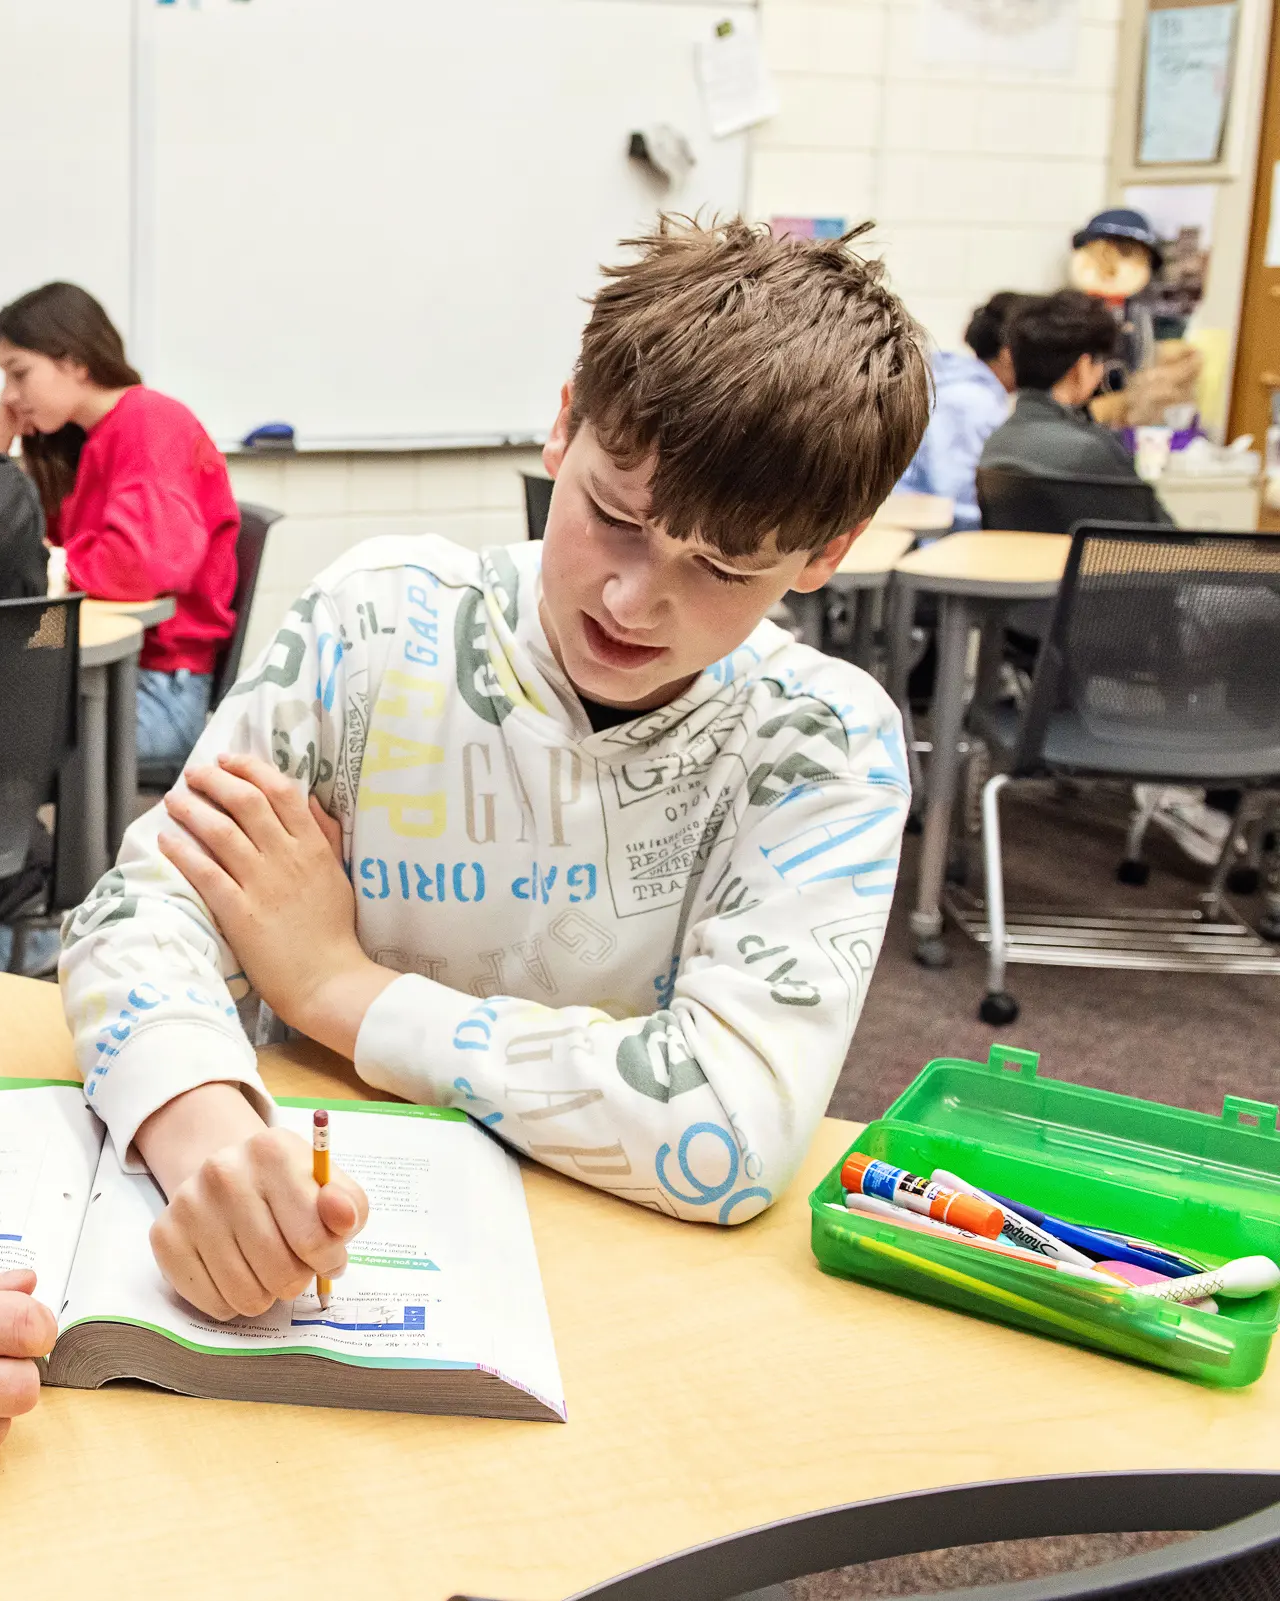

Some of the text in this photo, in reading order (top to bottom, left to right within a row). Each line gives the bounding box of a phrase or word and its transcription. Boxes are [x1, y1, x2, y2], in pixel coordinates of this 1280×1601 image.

[404, 584, 440, 667] GAP
[359, 857, 597, 904] GAP ORIG
[364, 1256, 392, 1265] ready
[248, 1325, 280, 1333] Without
[239, 1331, 273, 1340] Support
